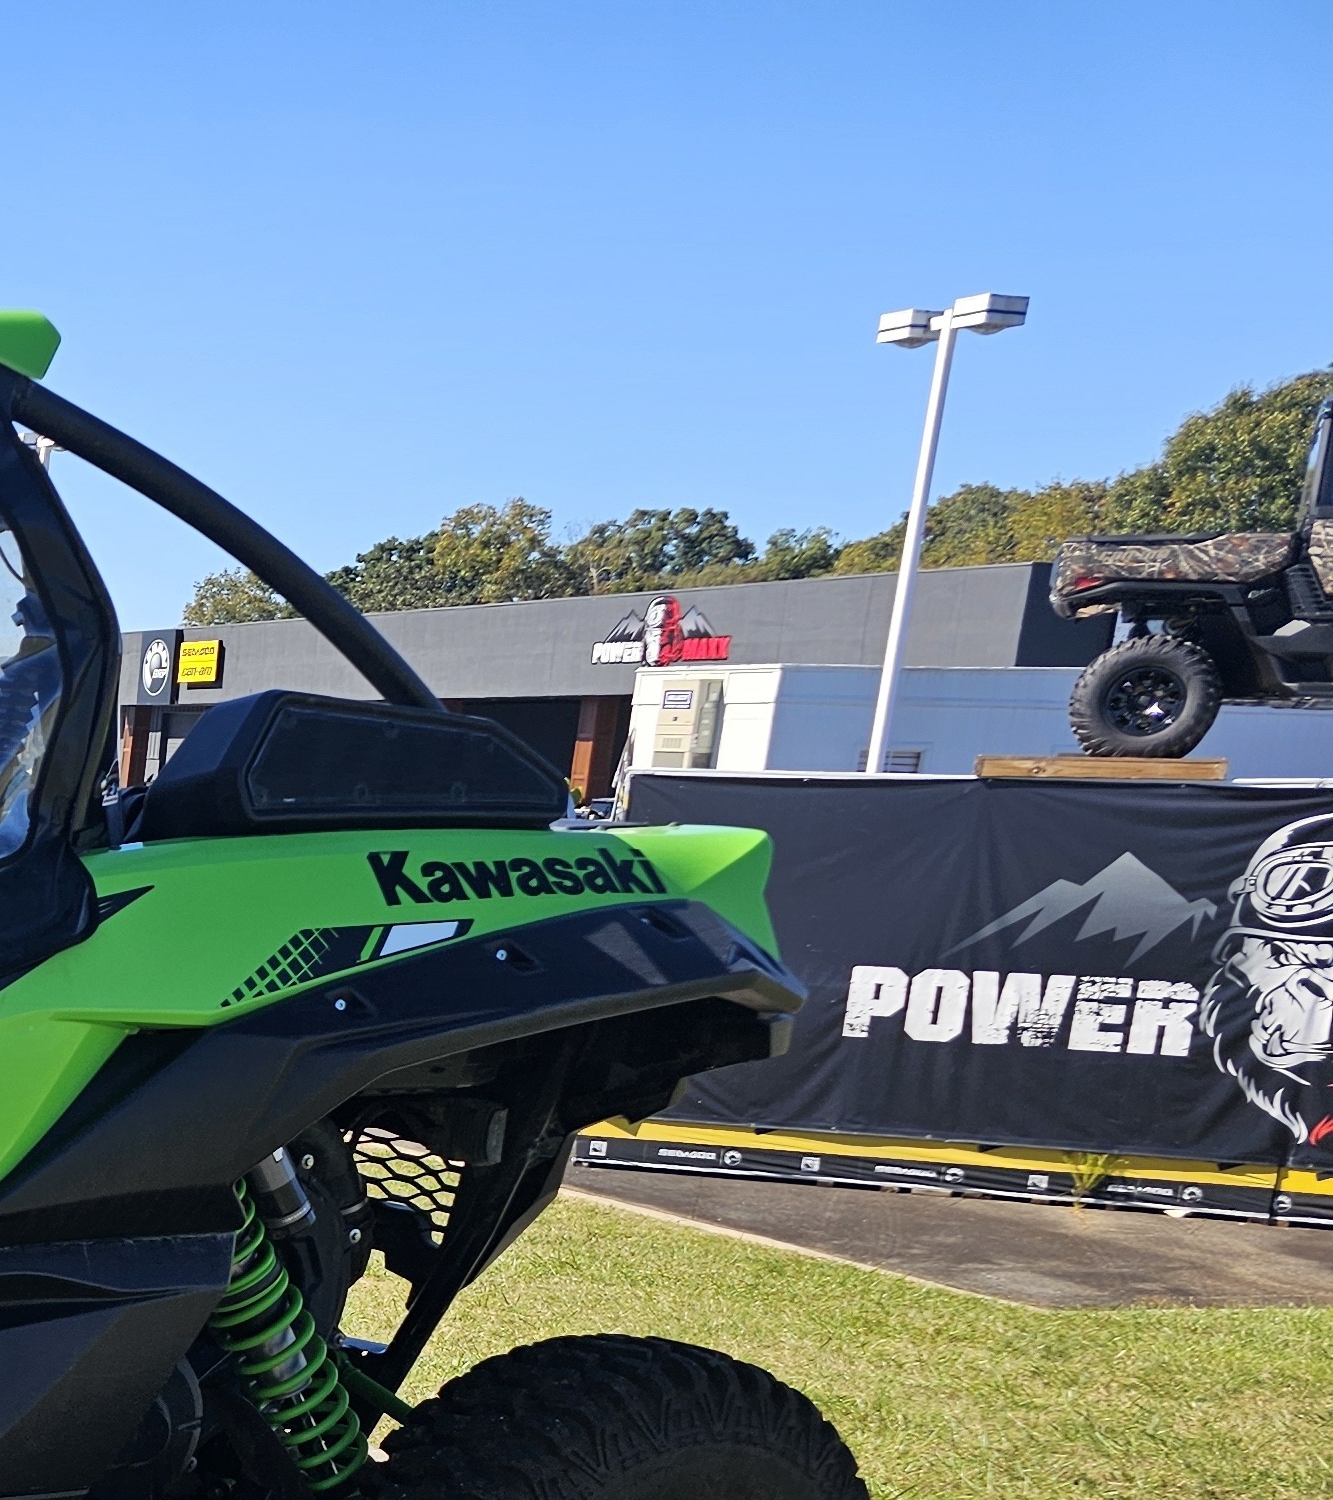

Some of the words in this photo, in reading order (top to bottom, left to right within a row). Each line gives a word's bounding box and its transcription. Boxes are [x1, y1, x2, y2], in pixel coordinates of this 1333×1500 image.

[592, 641, 644, 664] POWER
[366, 848, 668, 907] Kawasaki
[841, 965, 1201, 1058] POWER
